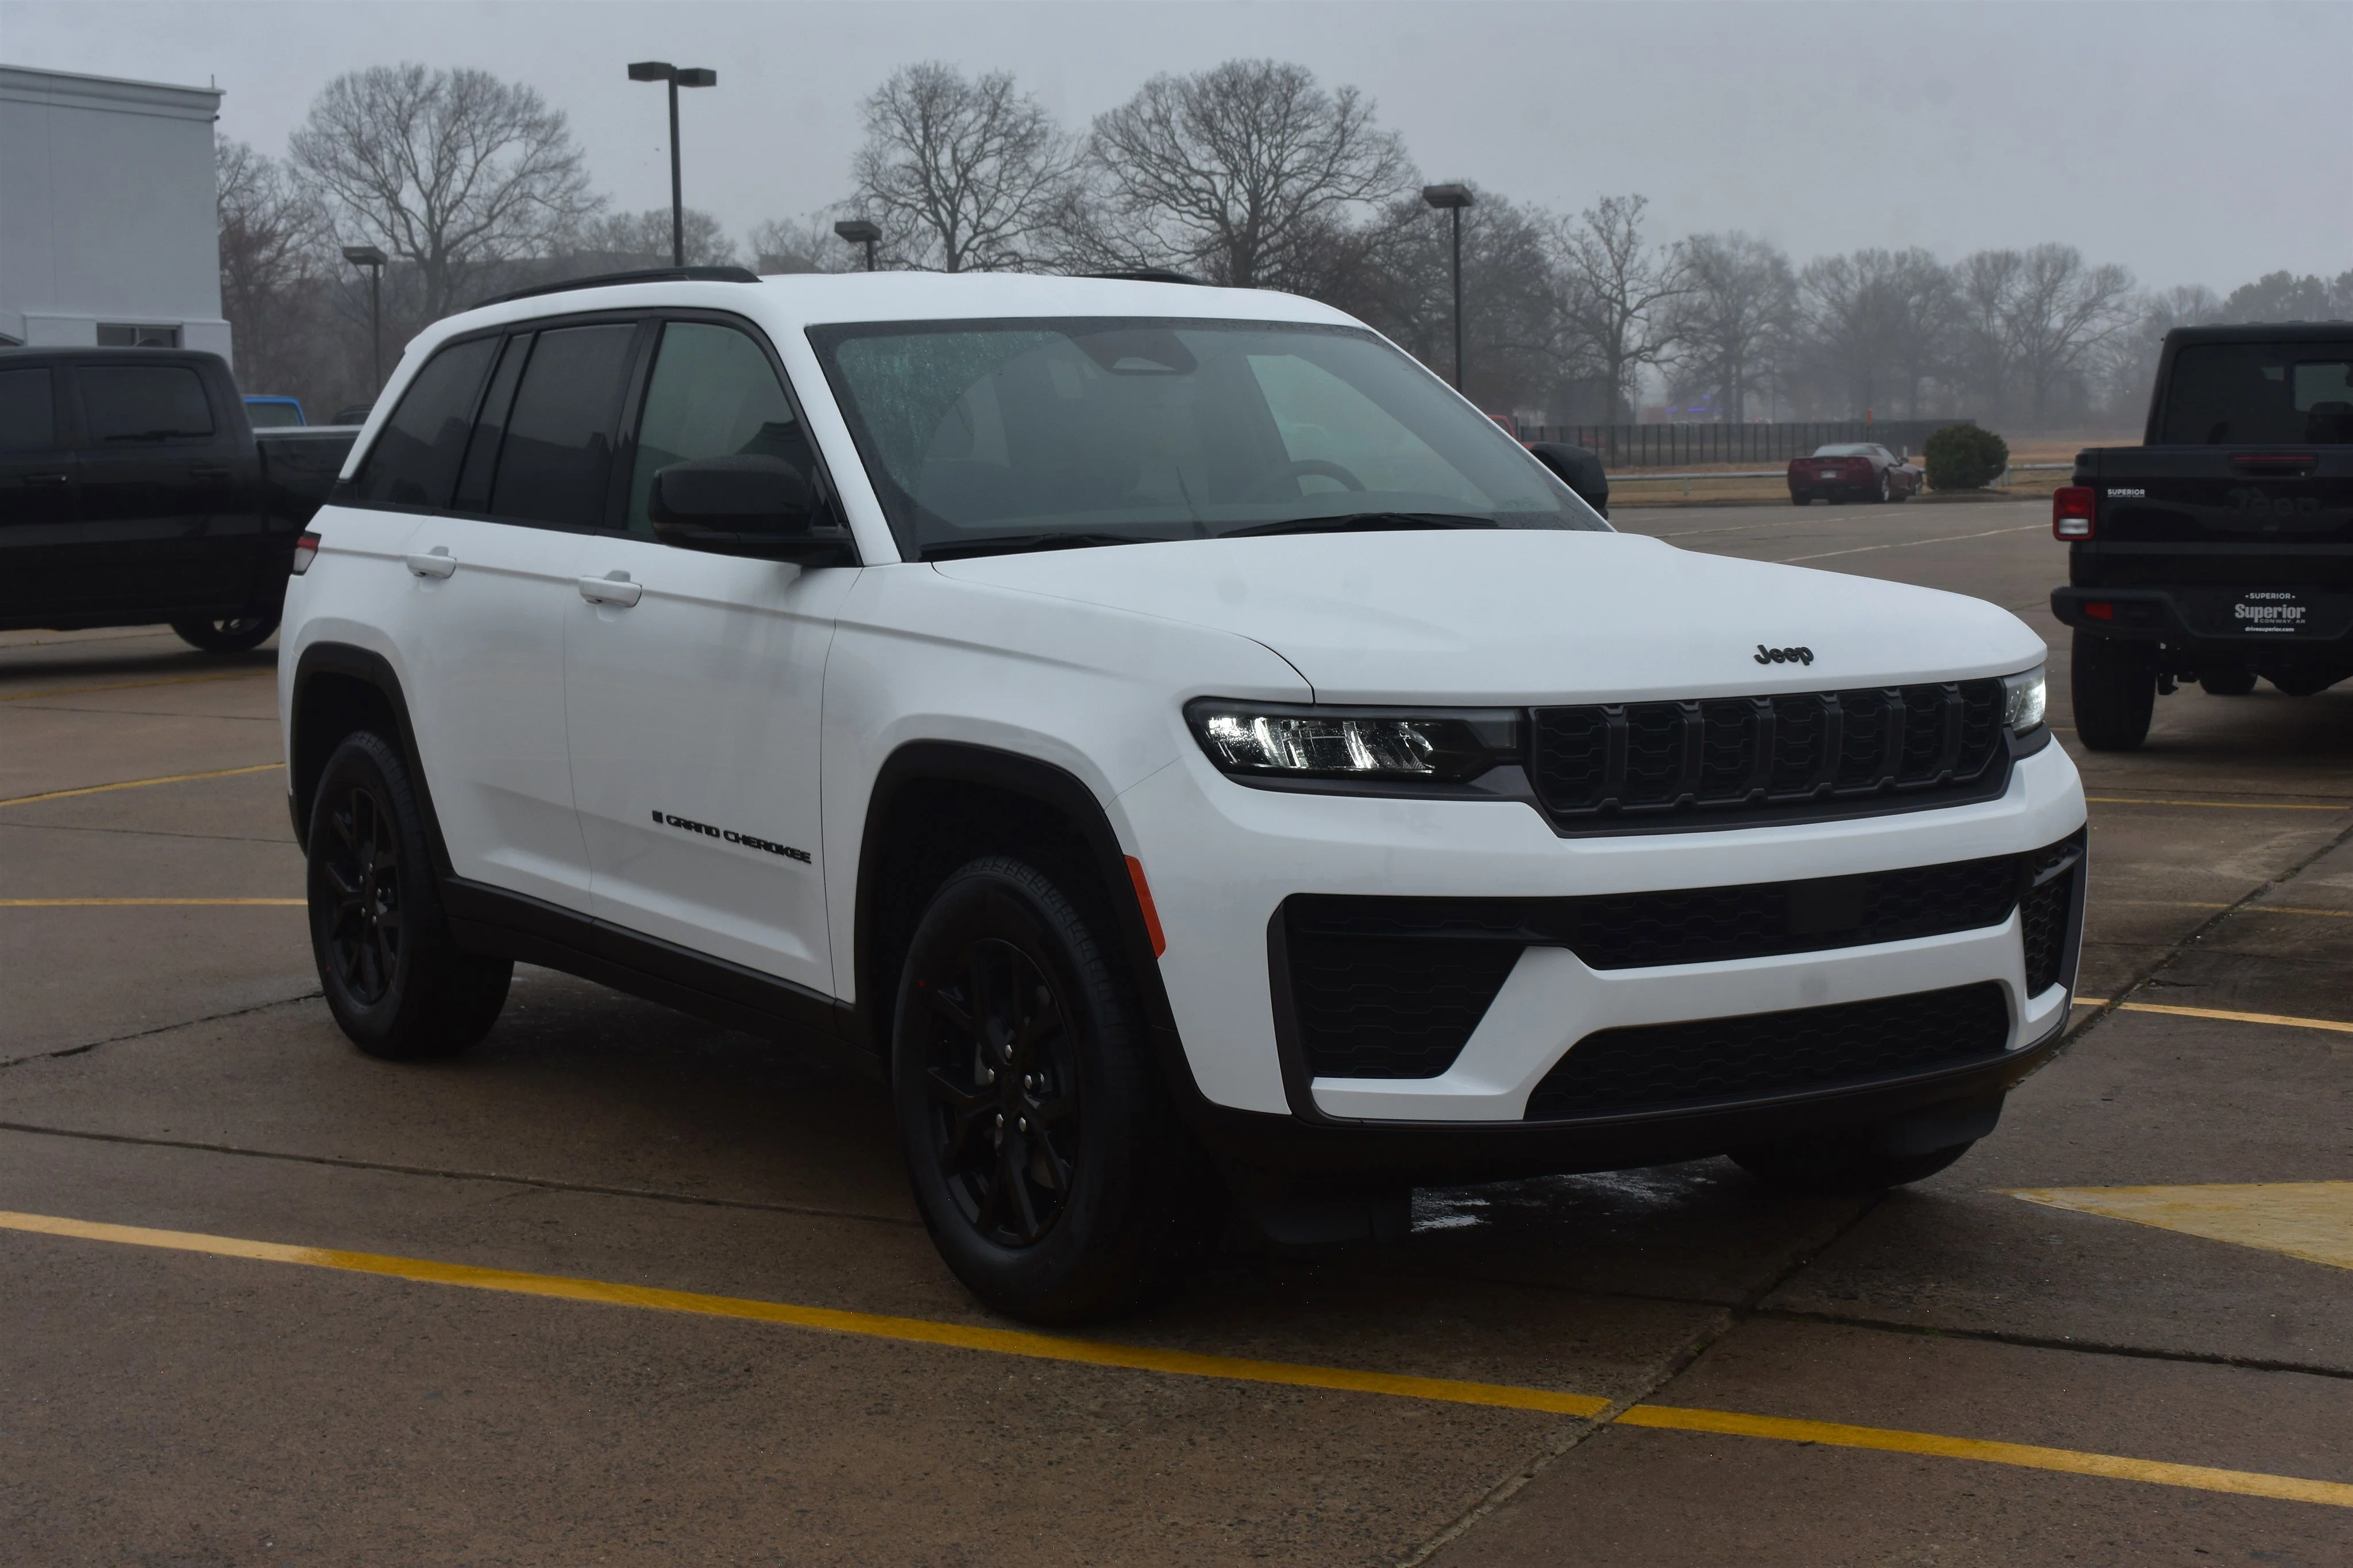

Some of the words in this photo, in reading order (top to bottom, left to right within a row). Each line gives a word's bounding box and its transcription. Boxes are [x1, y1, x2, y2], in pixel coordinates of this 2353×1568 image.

[2235, 604, 2306, 623] Superior
[1753, 644, 1814, 666] Jeep
[666, 815, 720, 837] GRAND
[724, 830, 812, 864] CHEROKEE
